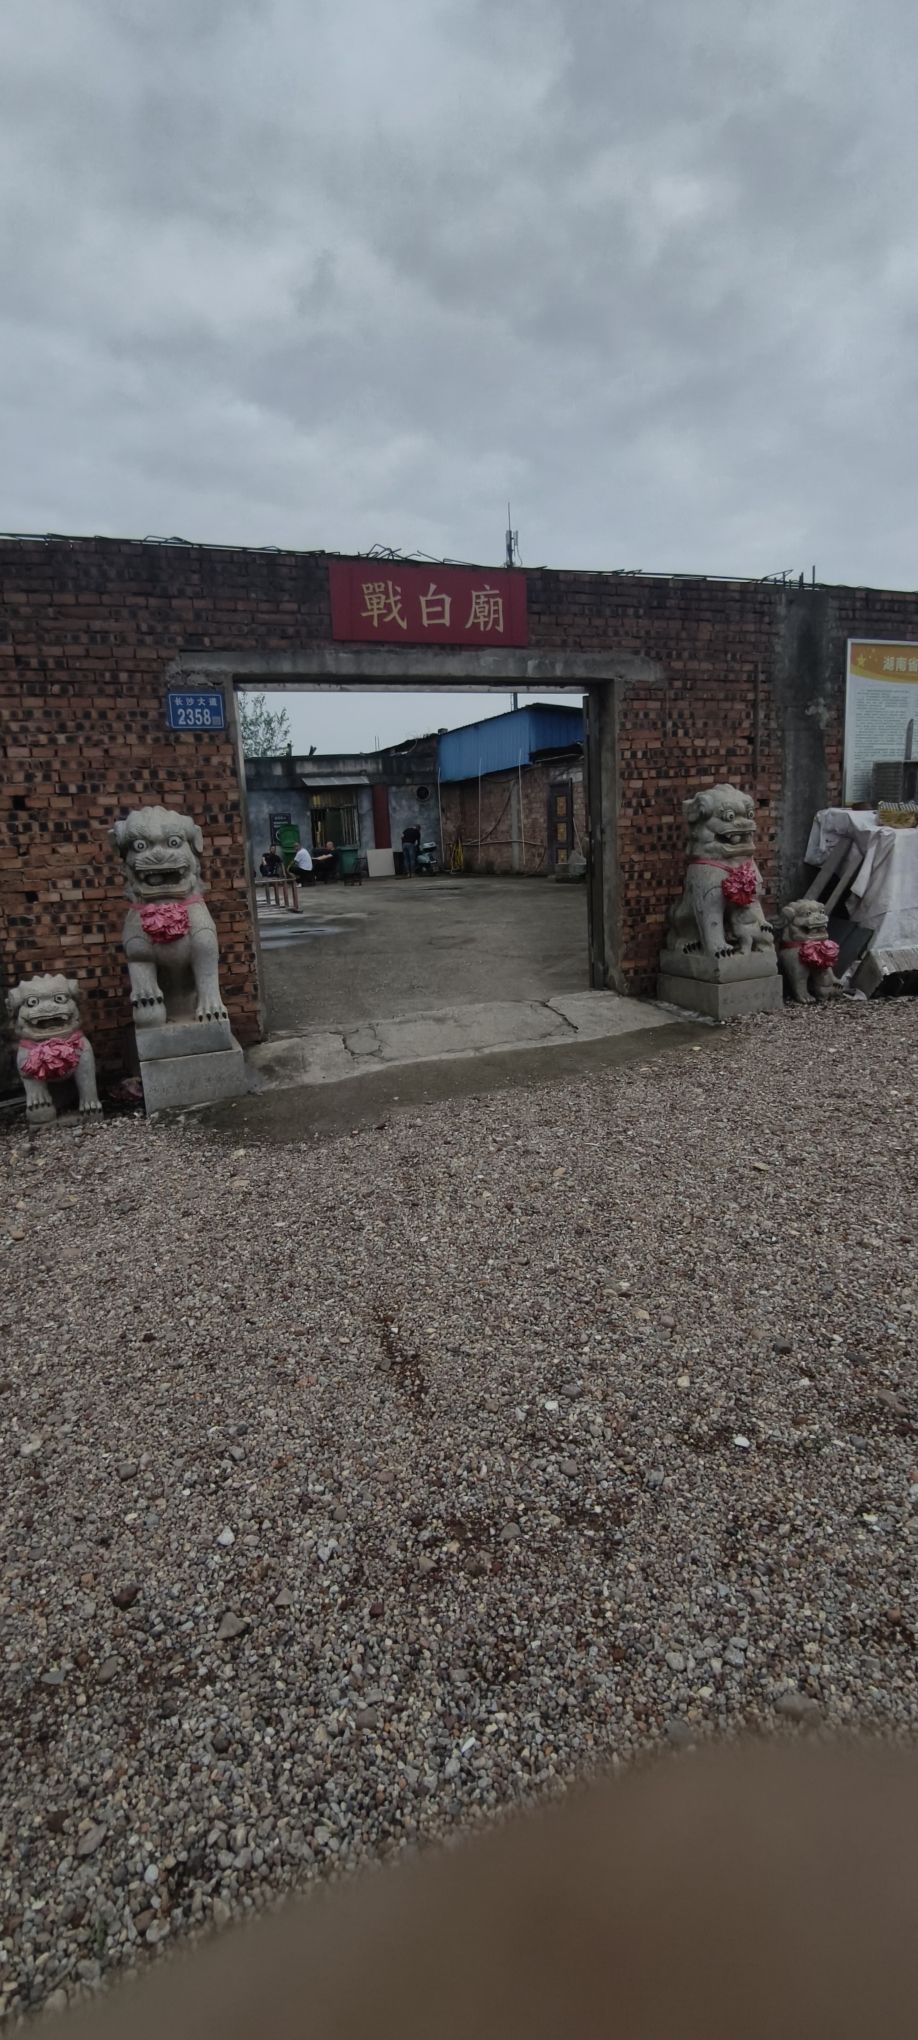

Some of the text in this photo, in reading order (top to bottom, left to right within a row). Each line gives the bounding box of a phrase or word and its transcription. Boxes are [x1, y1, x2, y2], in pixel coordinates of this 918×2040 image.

[360, 580, 504, 633] 戰白廟
[177, 708, 212, 725] 2358
